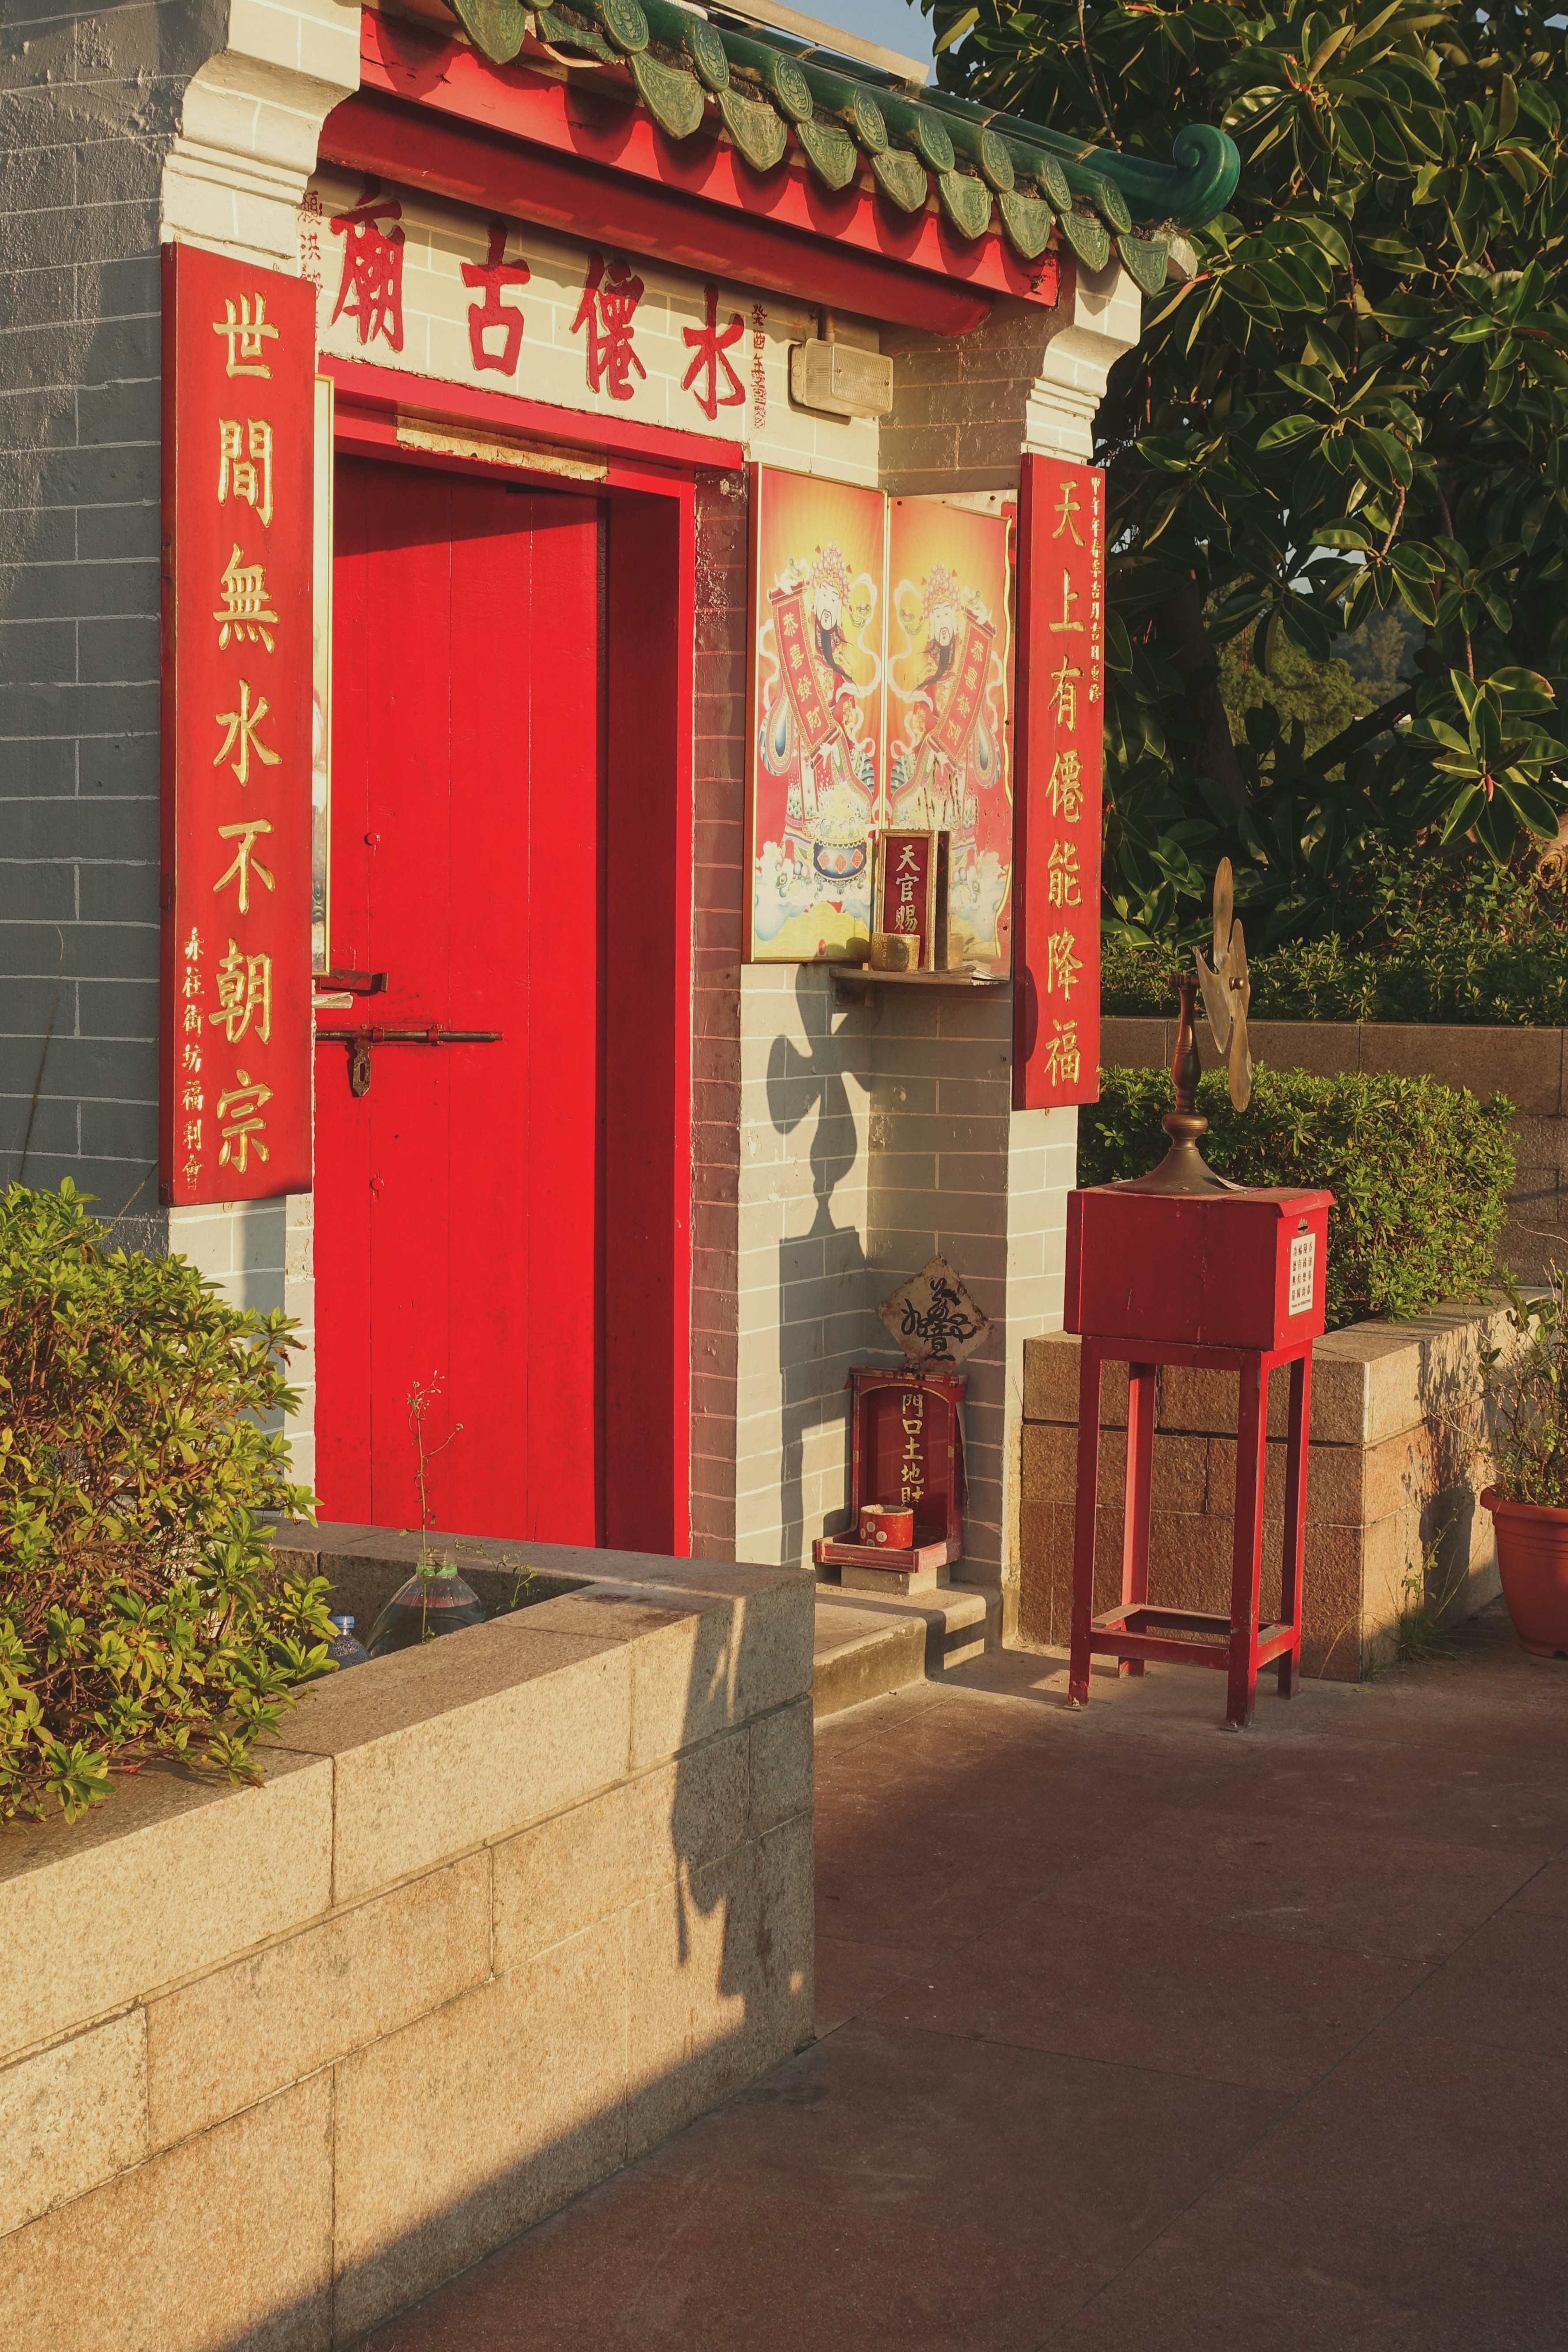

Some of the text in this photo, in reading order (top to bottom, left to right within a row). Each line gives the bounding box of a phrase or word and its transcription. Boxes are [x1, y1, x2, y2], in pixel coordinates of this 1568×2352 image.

[208, 290, 281, 1175] 世間無水不朝宗
[783, 613, 822, 734] 恭喜發財
[1045, 479, 1086, 1088] 天上有僊能降福
[894, 844, 921, 933] 天官賜
[181, 926, 205, 1190] 赤柱街坊福利會
